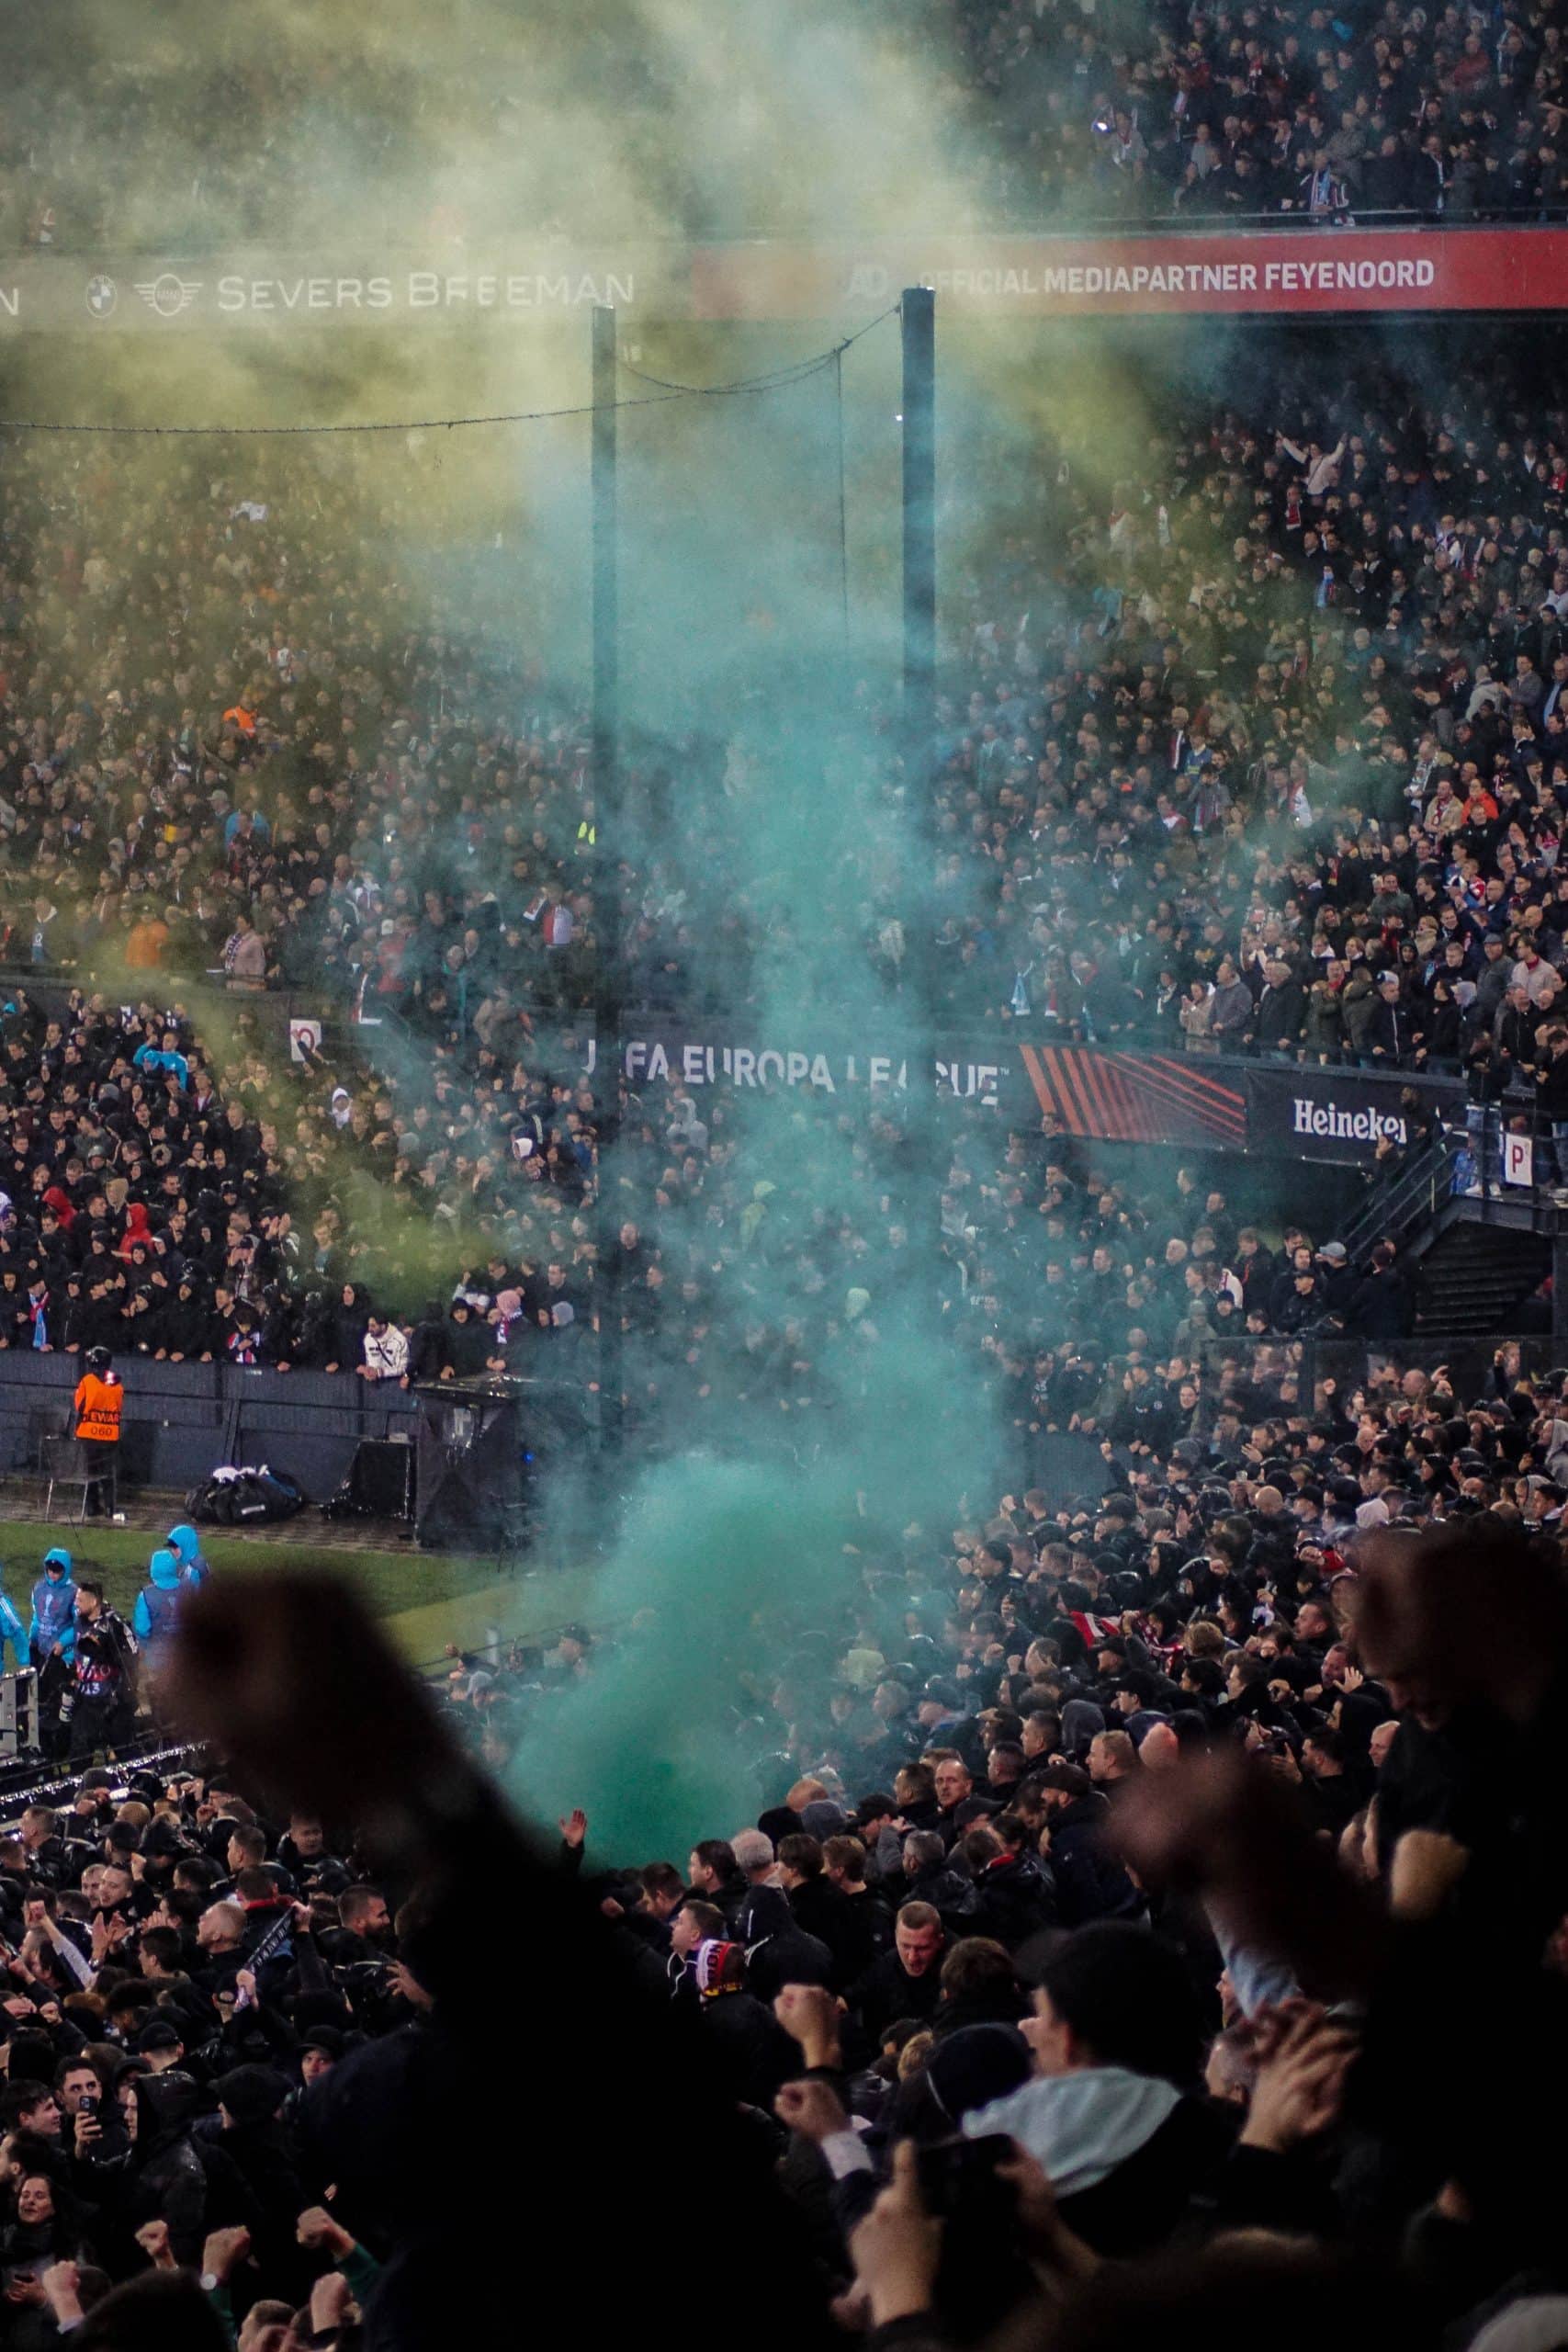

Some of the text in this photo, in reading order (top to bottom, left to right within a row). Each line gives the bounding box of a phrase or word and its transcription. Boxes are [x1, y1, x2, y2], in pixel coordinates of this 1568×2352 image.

[217, 275, 393, 312] SEVERS
[1043, 264, 1258, 295] MEDIAPARTNER
[1264, 259, 1435, 289] FEYENOORD
[1512, 1145, 1524, 1173] P
